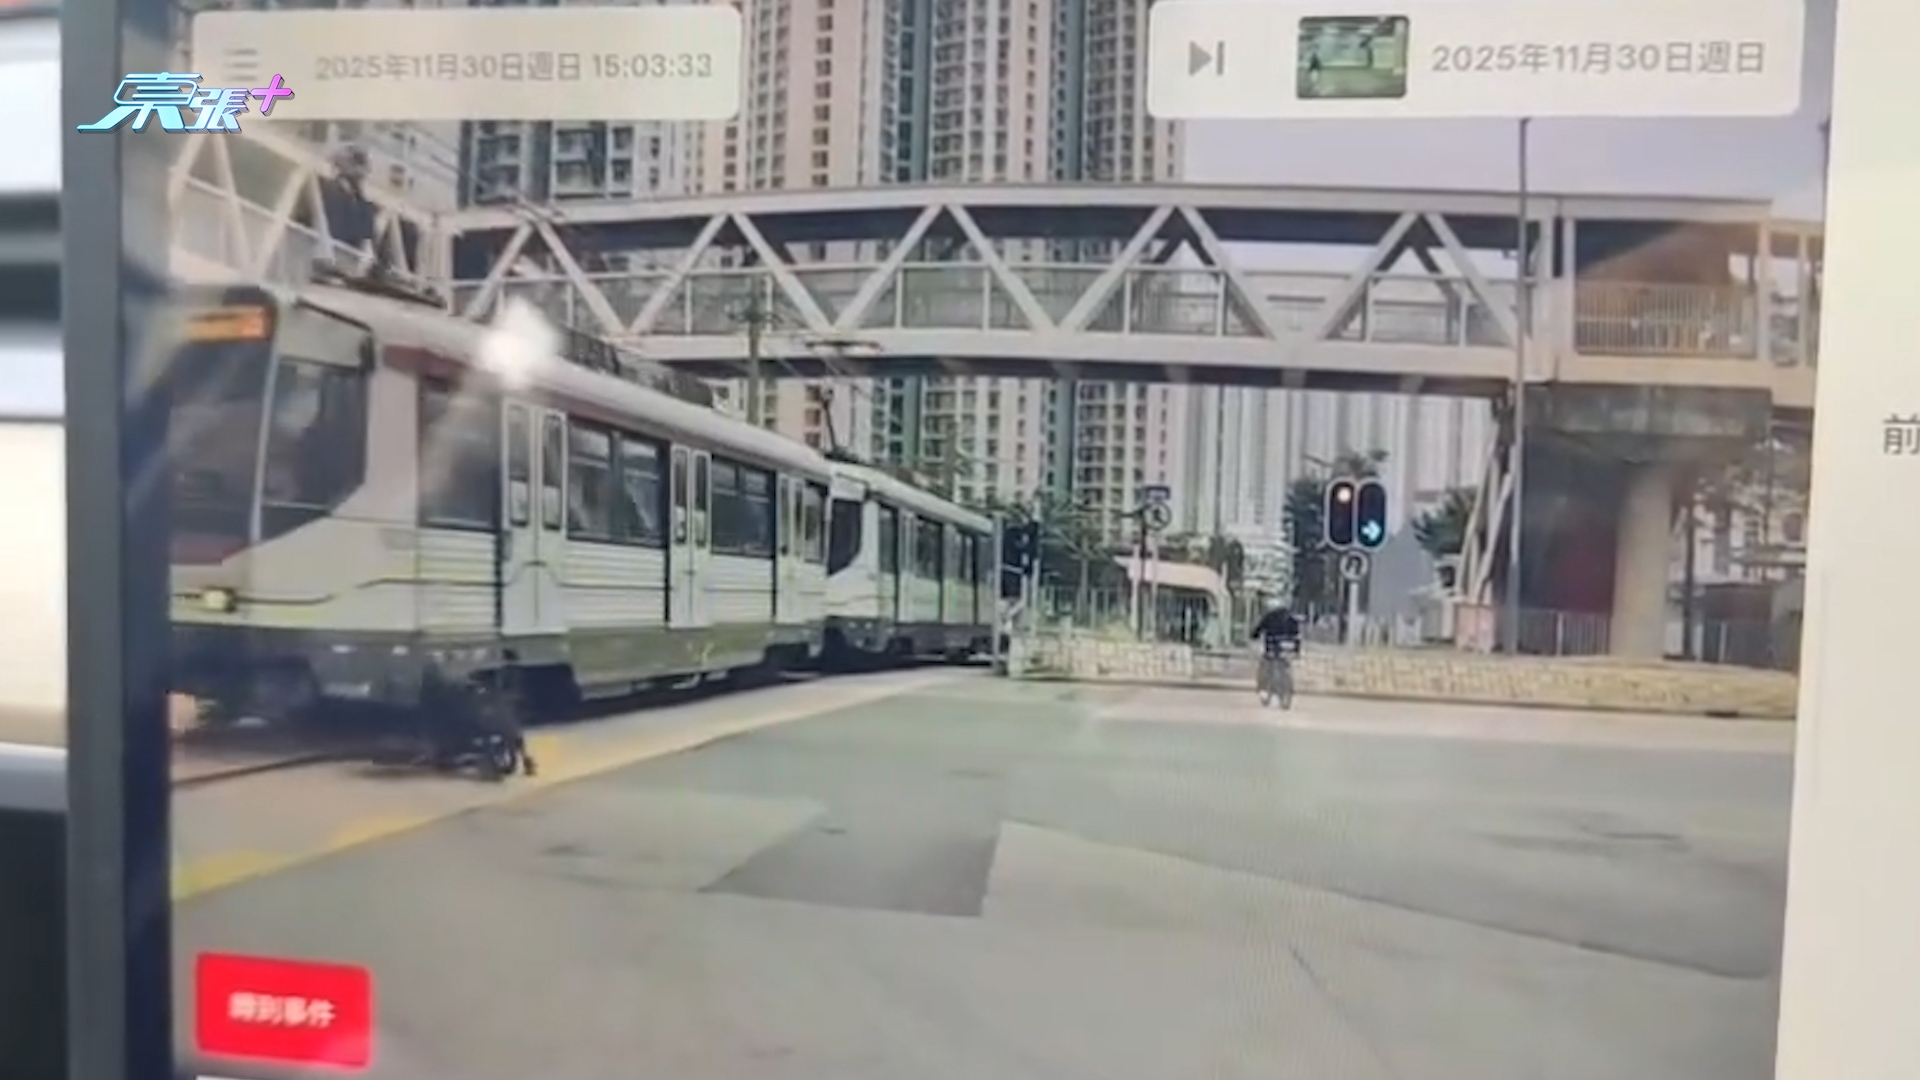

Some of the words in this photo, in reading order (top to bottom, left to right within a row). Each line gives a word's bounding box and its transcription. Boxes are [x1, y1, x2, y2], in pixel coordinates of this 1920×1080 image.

[315, 51, 581, 81] 2025年11月30日週日
[1432, 41, 1764, 74] 2025年11月30日週日
